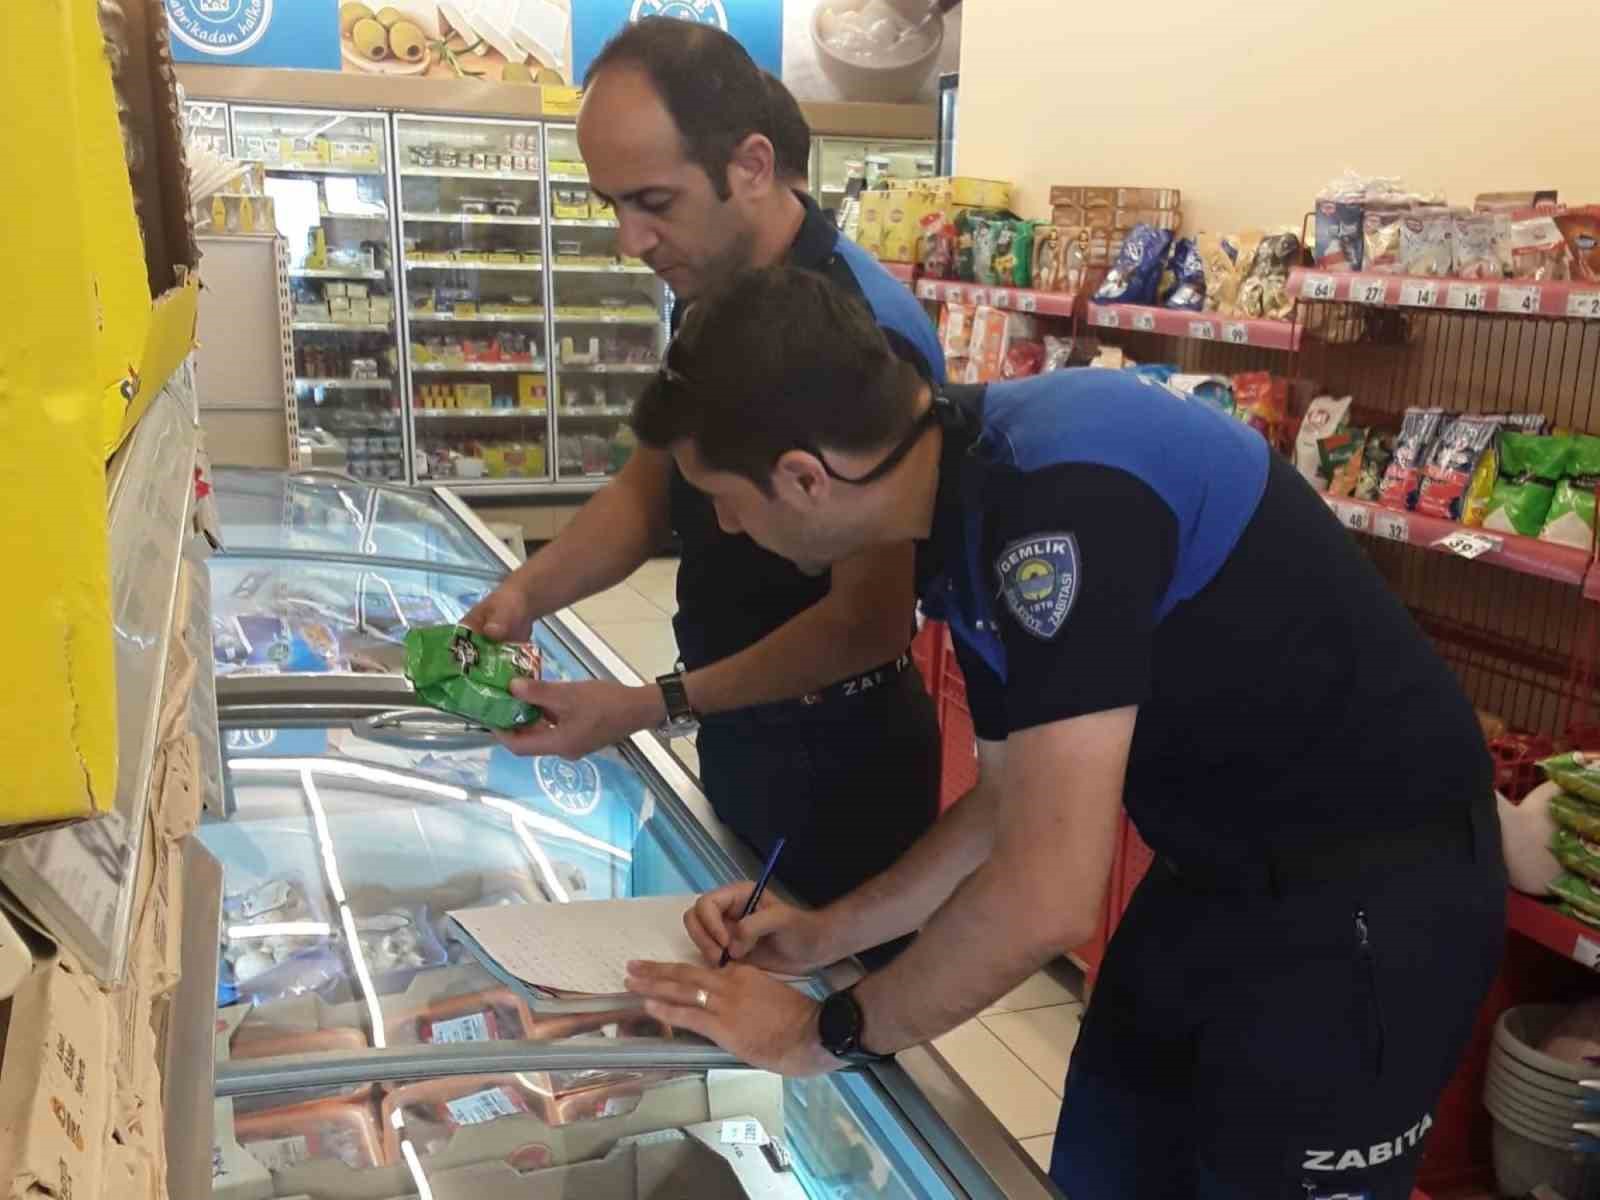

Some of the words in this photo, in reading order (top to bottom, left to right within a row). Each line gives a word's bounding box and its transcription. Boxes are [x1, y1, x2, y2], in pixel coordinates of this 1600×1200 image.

[168, 0, 239, 44] abrikadan
[1314, 283, 1329, 297] 64
[1365, 286, 1379, 301] 27
[1416, 289, 1430, 305] 14
[1464, 292, 1477, 308] 14
[1388, 522, 1403, 539] 32
[1301, 1112, 1433, 1171] ZABITA
